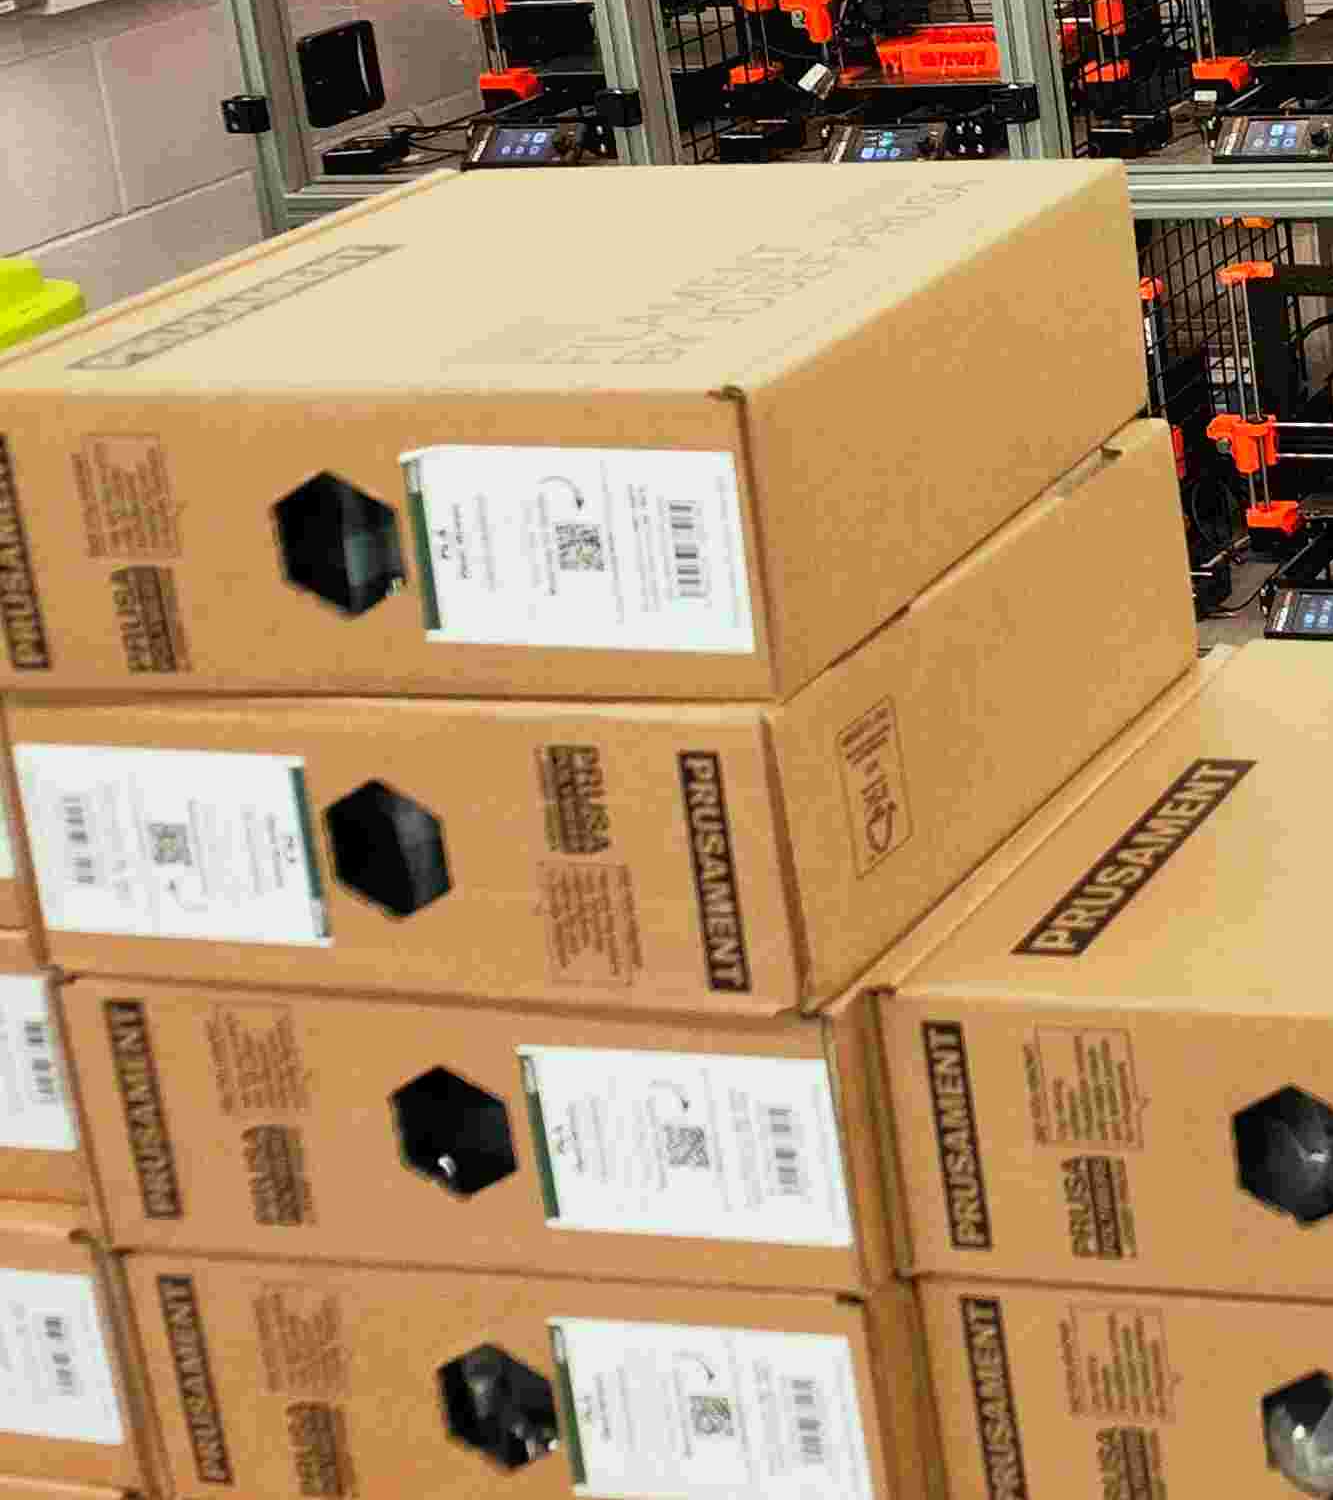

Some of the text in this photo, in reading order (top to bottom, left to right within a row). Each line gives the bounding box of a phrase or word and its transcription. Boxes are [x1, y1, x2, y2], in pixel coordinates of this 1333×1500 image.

[682, 754, 746, 989] PRUSAMENT
[1025, 762, 1243, 952] PRUSAMENT
[108, 1006, 178, 1218] PRUSAMENT
[926, 1028, 988, 1247] PRUSAMENT
[160, 1280, 232, 1478] PRUSAMENT
[964, 1299, 1025, 1500] RUSAMENT
